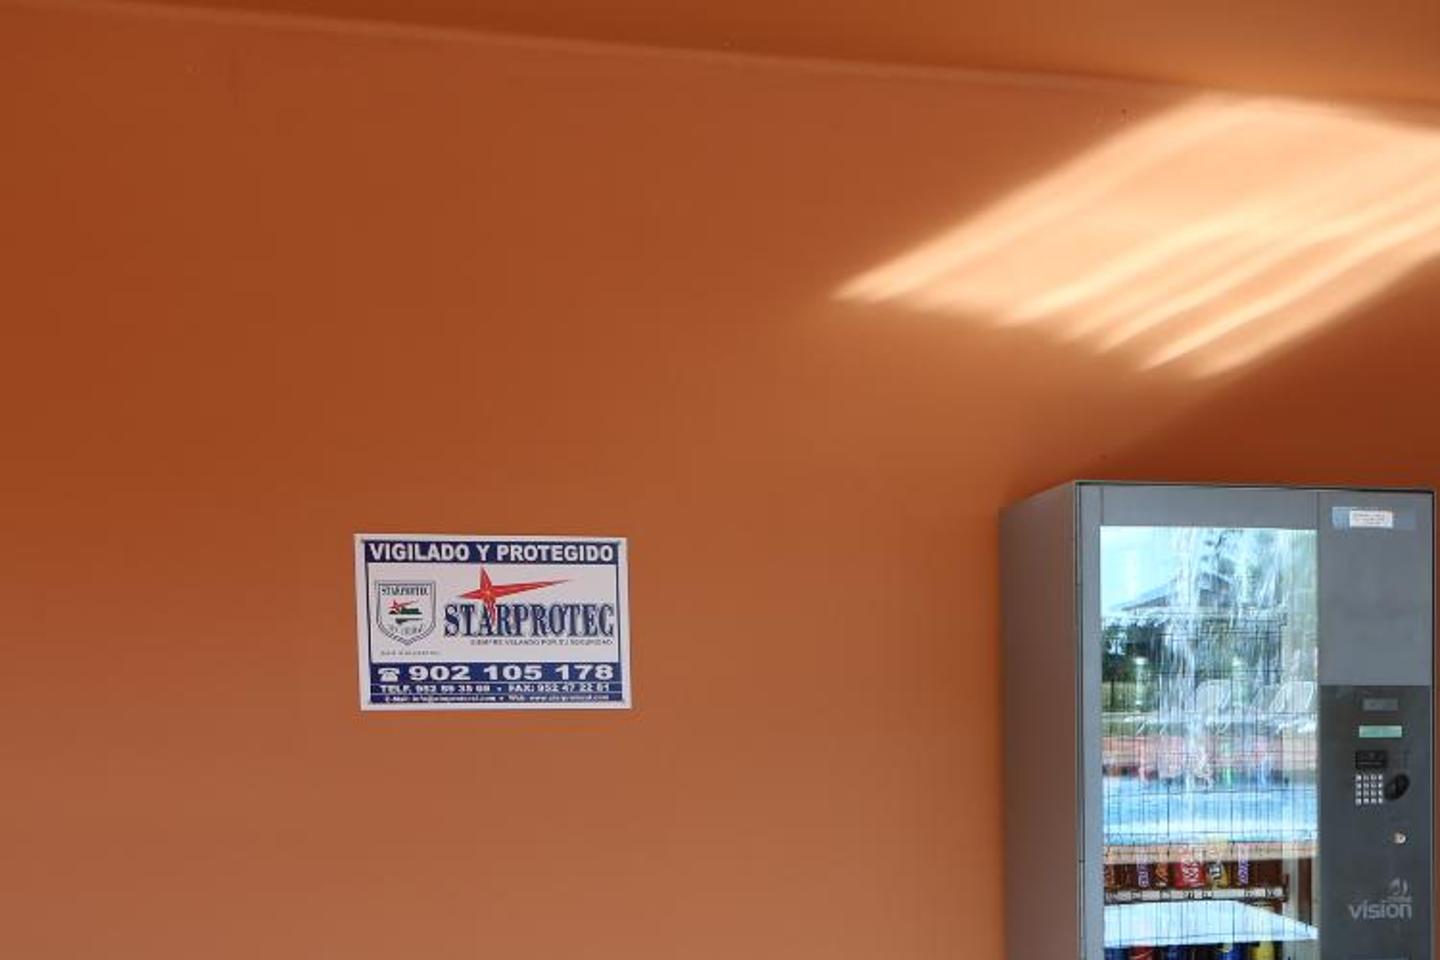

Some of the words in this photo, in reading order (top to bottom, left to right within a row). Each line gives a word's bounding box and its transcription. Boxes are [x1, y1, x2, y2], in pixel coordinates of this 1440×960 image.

[369, 542, 469, 561] VIGILADO
[476, 544, 490, 561] Y
[496, 544, 613, 562] PROTEGIDO
[444, 602, 615, 638] STARPROTEC
[408, 664, 471, 681] 902
[483, 664, 542, 681] 105
[555, 664, 614, 681] 178
[1347, 898, 1413, 921] vision
